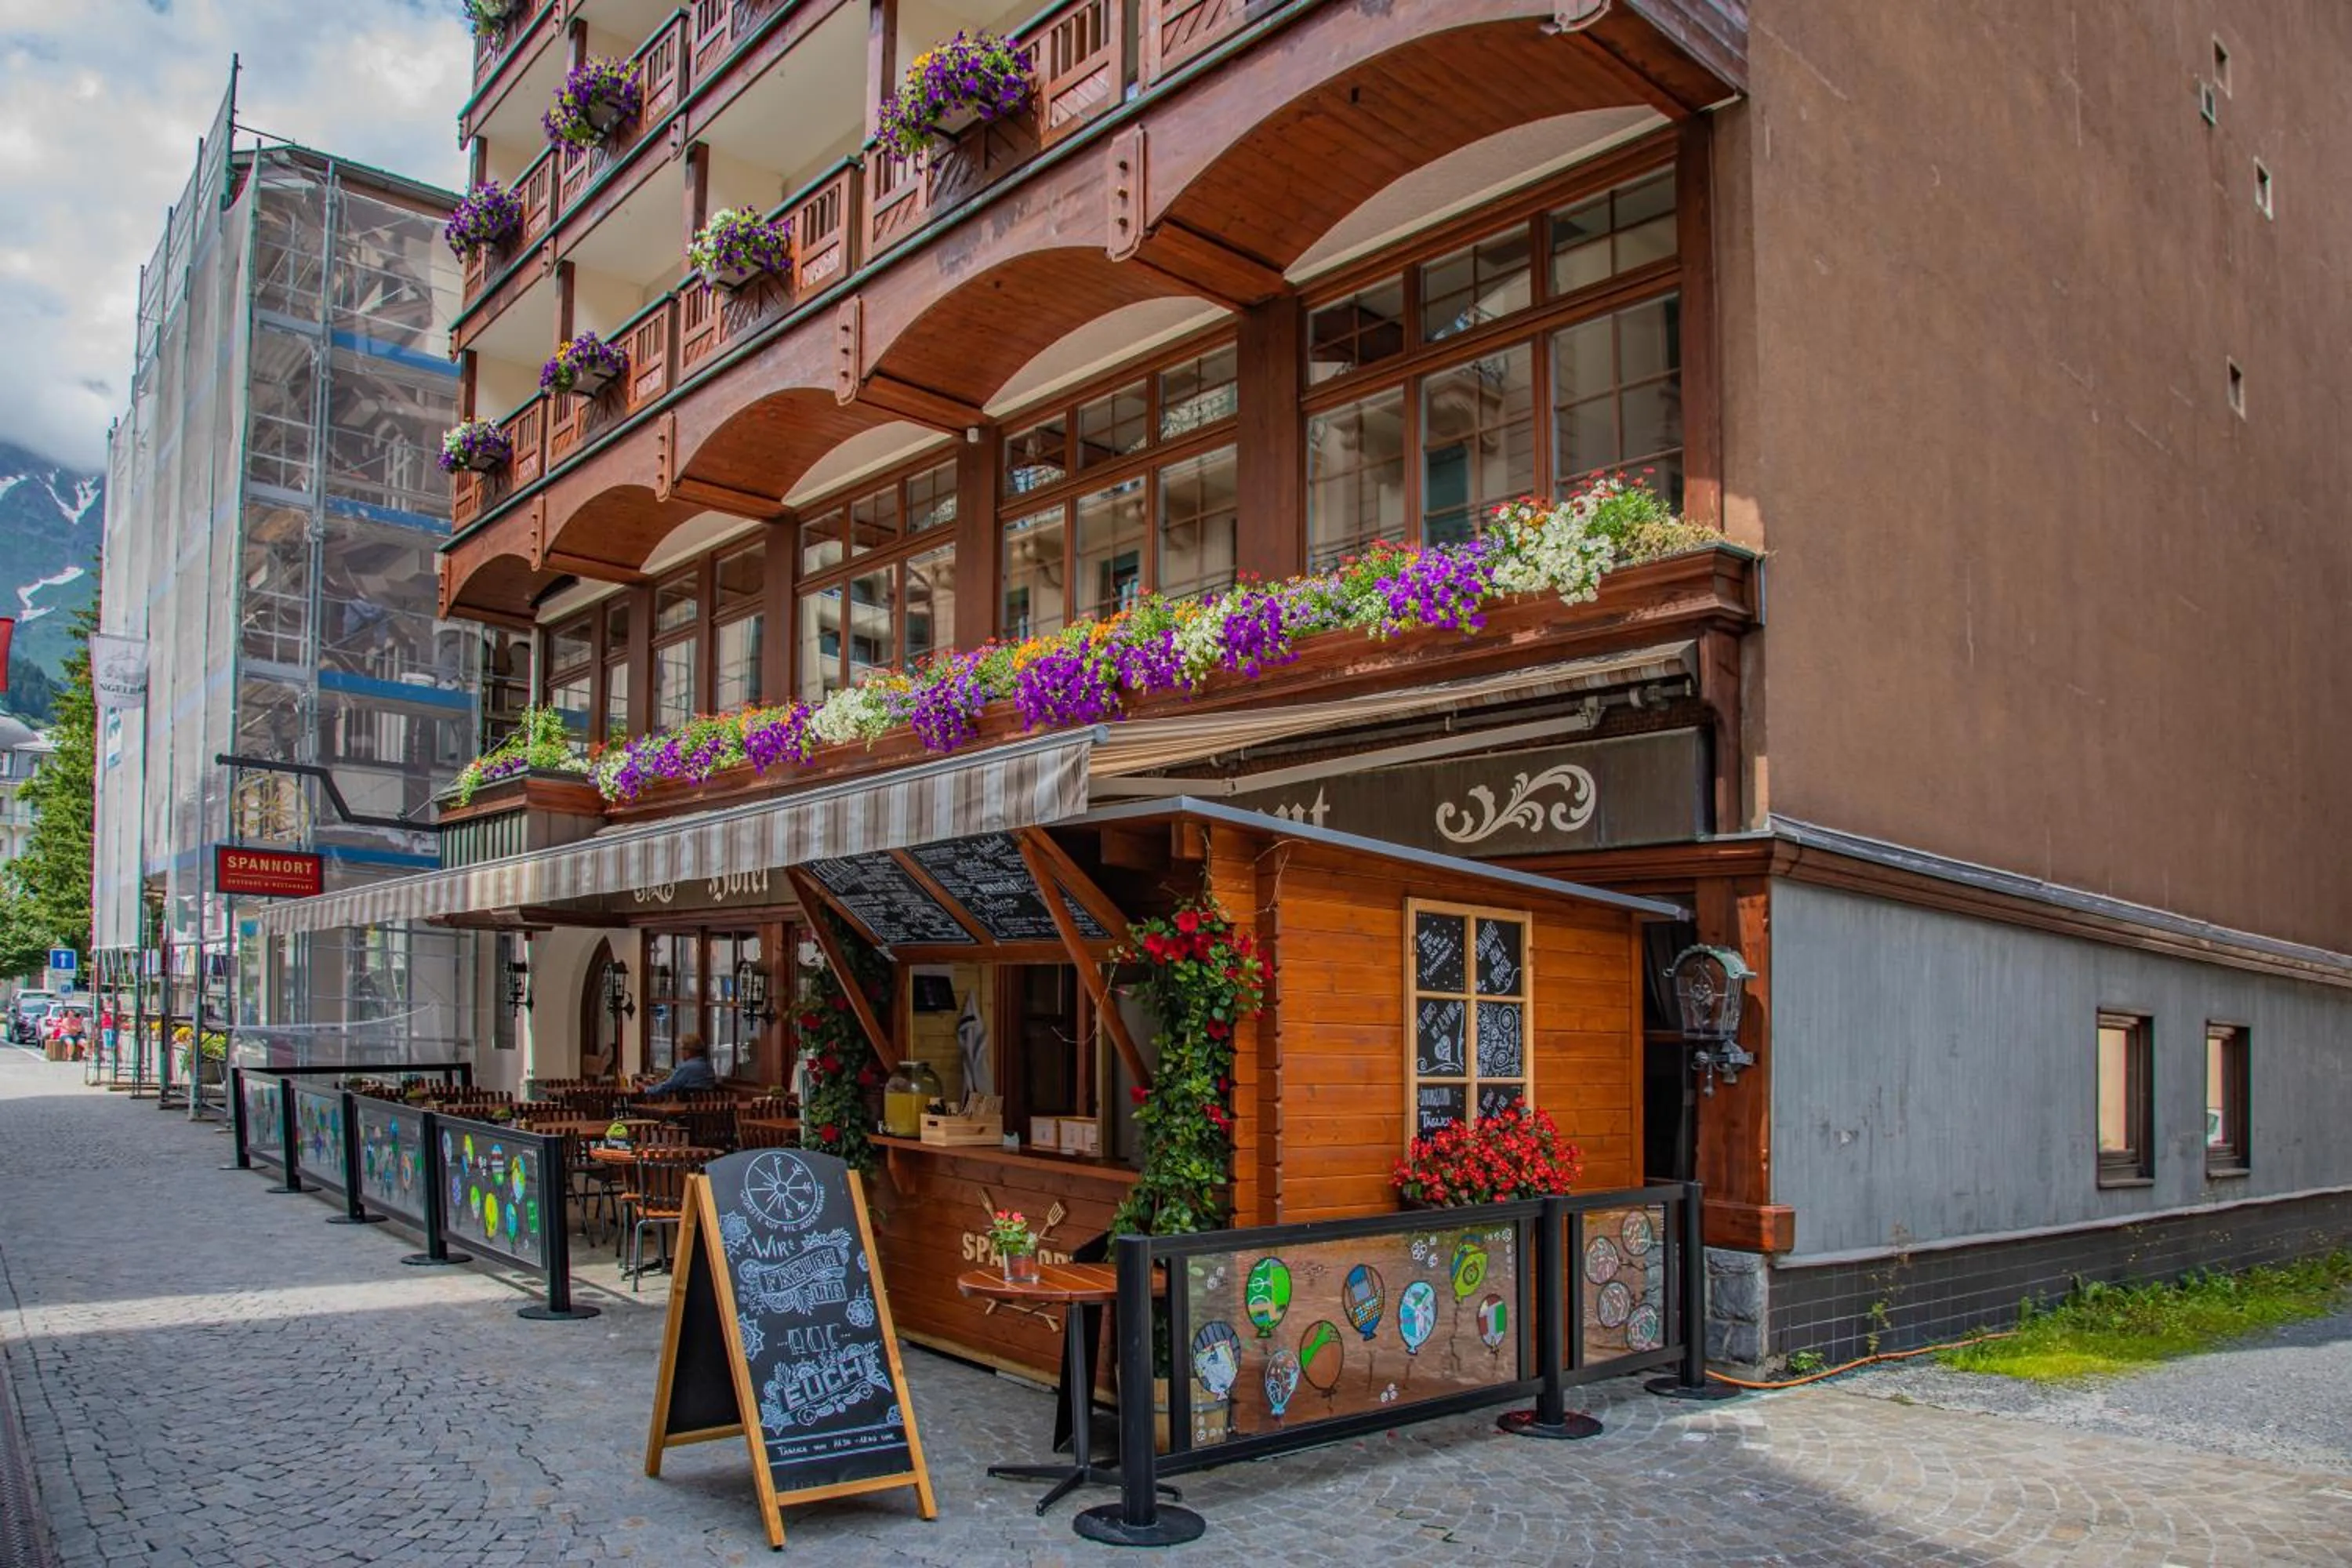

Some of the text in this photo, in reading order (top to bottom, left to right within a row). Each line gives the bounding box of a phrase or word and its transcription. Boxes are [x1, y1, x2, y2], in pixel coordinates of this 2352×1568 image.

[227, 855, 313, 874] SPANNORT
[753, 1234, 790, 1258] WIR
[813, 1283, 844, 1301] UNS
[786, 1323, 840, 1356] AUF
[783, 1357, 866, 1410] EUCH
